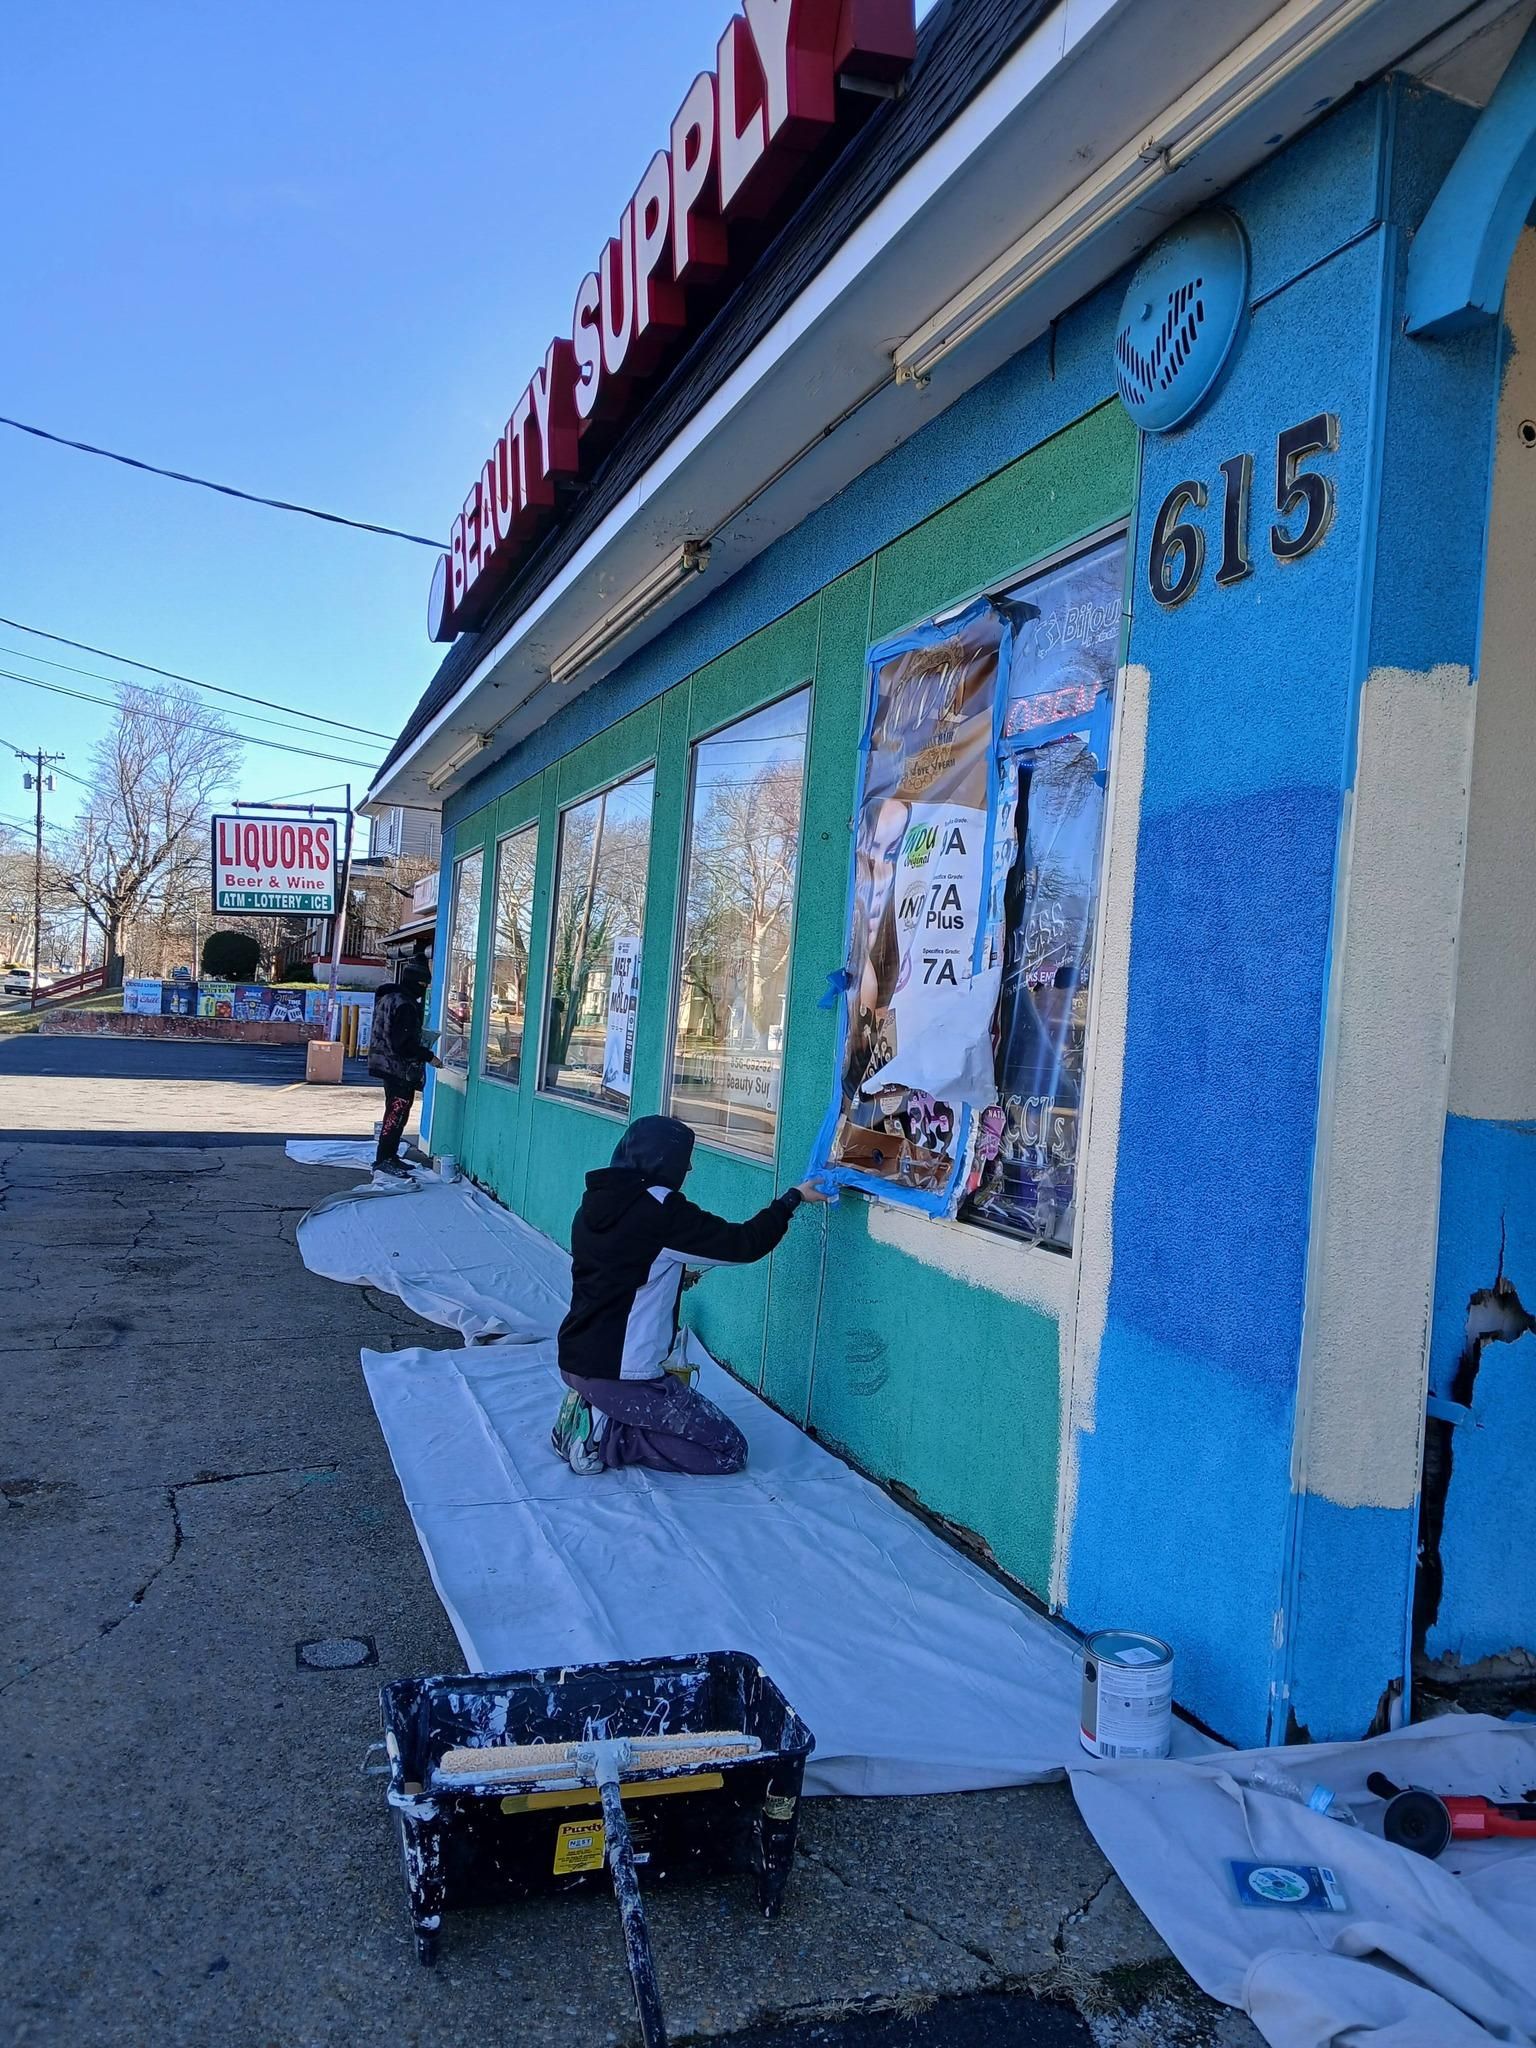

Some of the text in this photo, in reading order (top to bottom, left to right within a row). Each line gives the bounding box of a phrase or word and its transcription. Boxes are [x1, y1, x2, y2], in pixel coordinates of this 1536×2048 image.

[452, 0, 804, 614] BEAUTY SUPPLY
[1149, 412, 1338, 606] 615
[1062, 599, 1122, 646] Bijou
[219, 822, 330, 872] LIQUORS
[225, 874, 325, 890] Beer & Wine
[223, 893, 328, 910] ATM LOTTERY ICE
[929, 883, 962, 911] 7A
[926, 911, 965, 930] Plus
[923, 958, 958, 986] 7A
[726, 1072, 754, 1096] Beauty
[562, 1823, 604, 1835] Purdy
